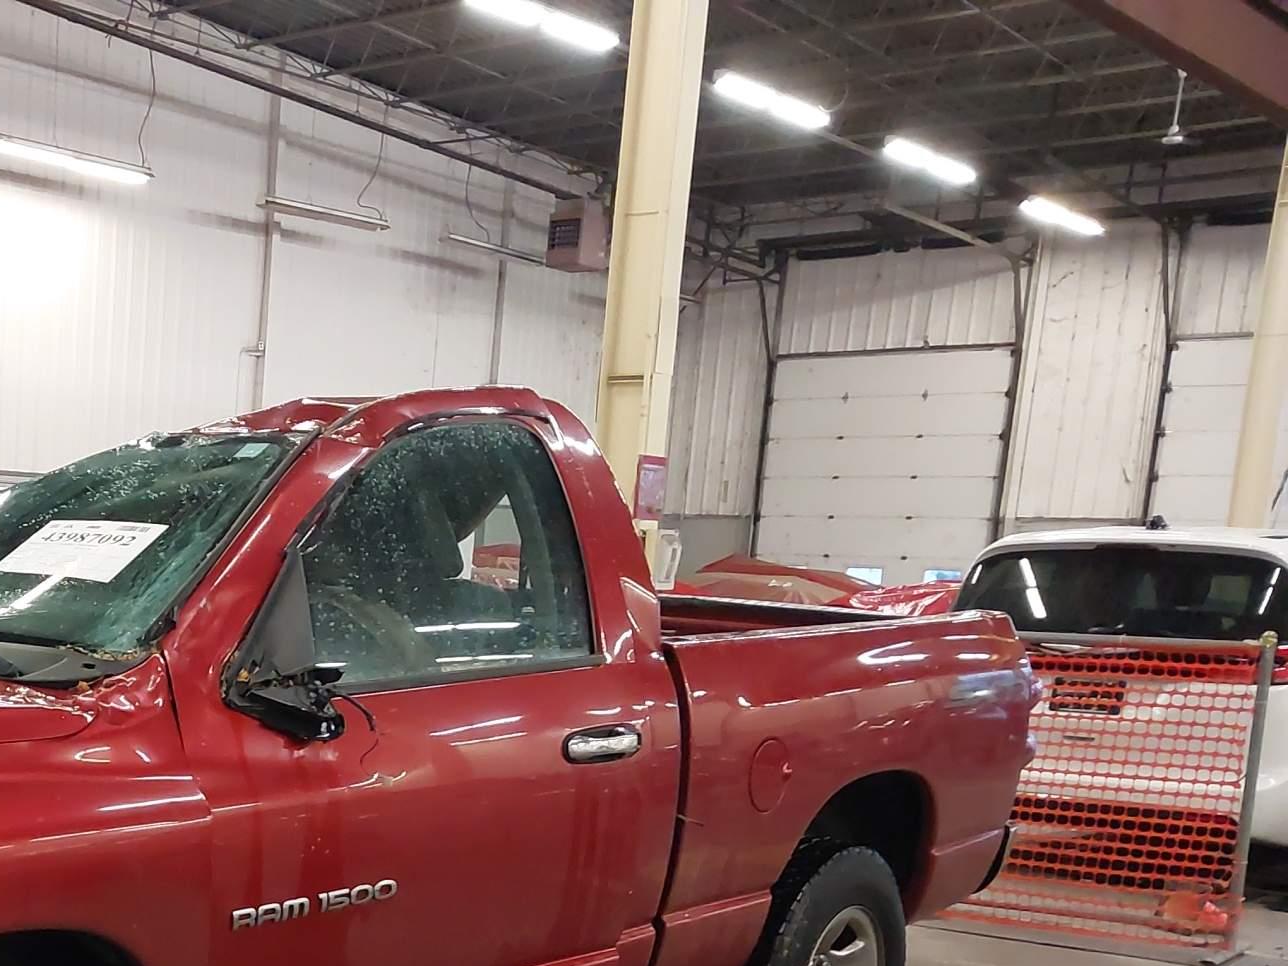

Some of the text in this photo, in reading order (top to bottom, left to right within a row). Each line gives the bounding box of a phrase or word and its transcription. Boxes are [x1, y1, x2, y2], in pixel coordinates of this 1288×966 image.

[42, 532, 136, 546] 43987092
[231, 878, 399, 931] RAM 1500
